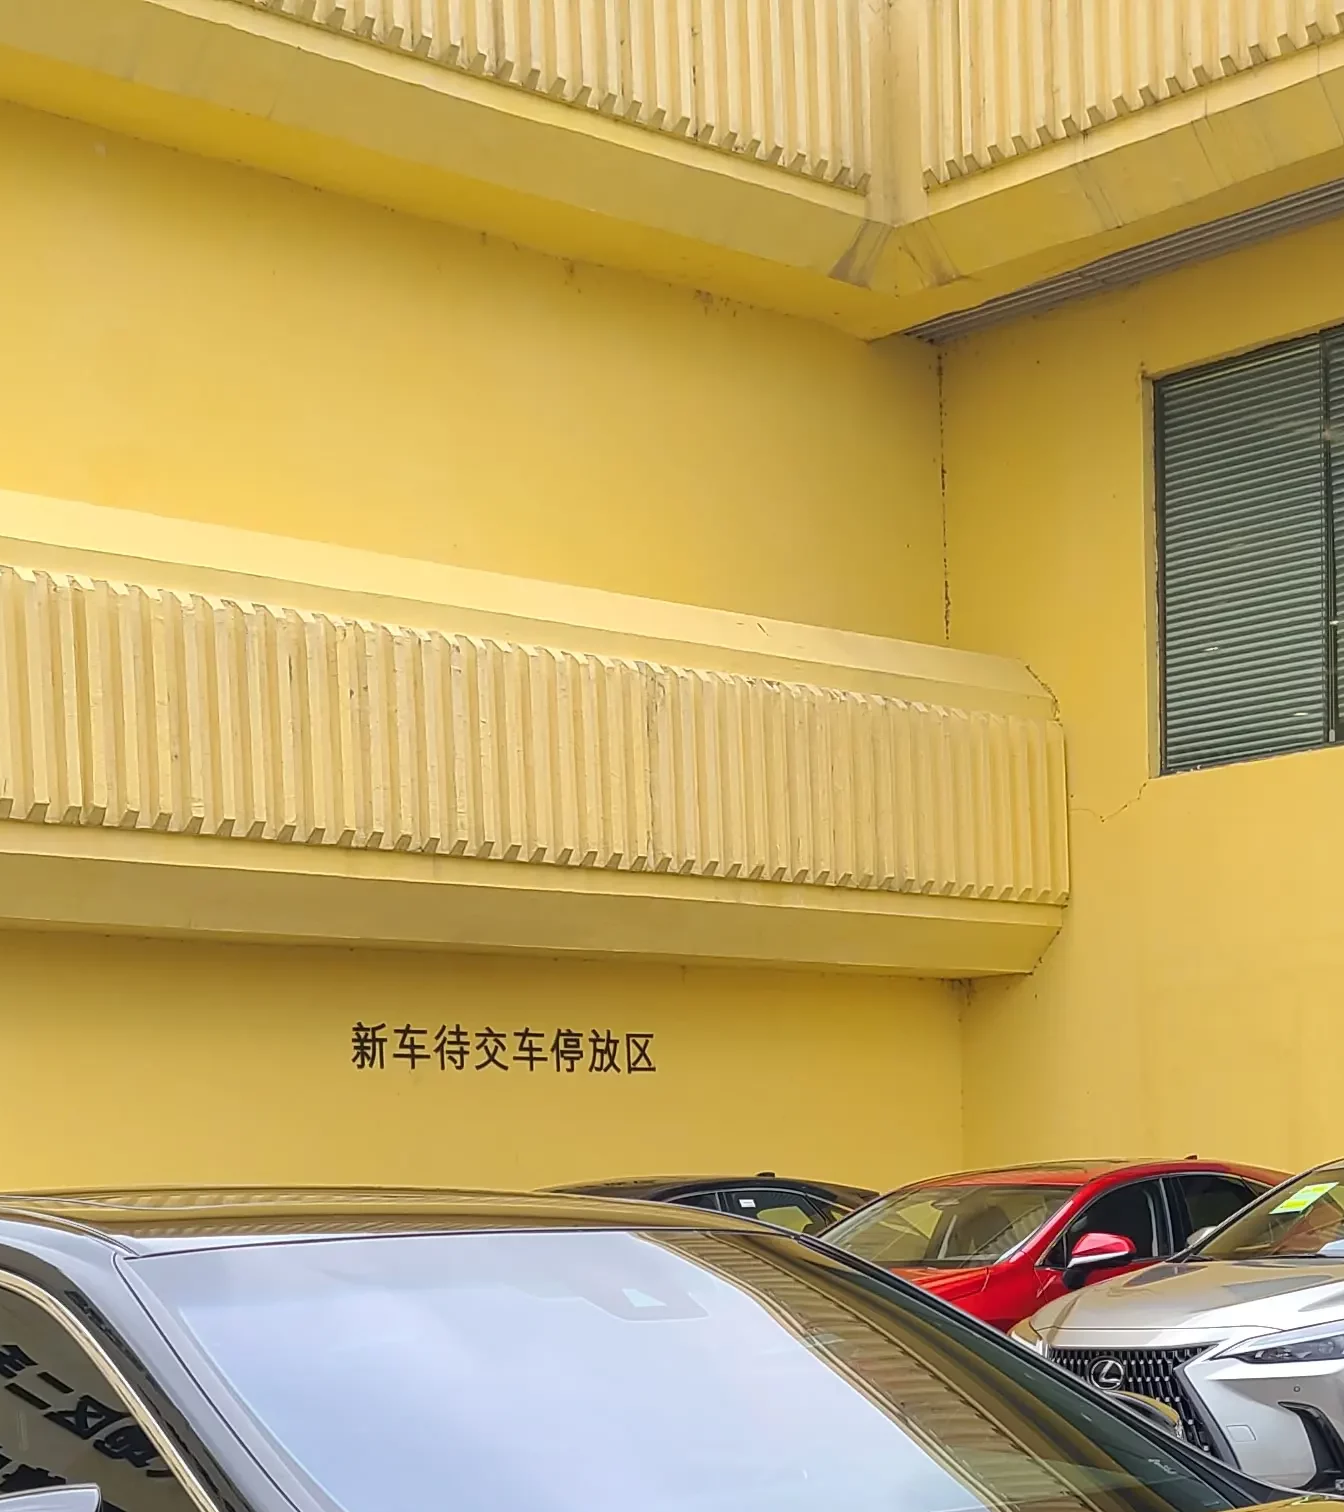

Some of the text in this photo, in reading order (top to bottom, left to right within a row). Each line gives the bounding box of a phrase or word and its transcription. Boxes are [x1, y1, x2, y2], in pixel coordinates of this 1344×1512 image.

[351, 1021, 657, 1074] 新车待交车停放区
